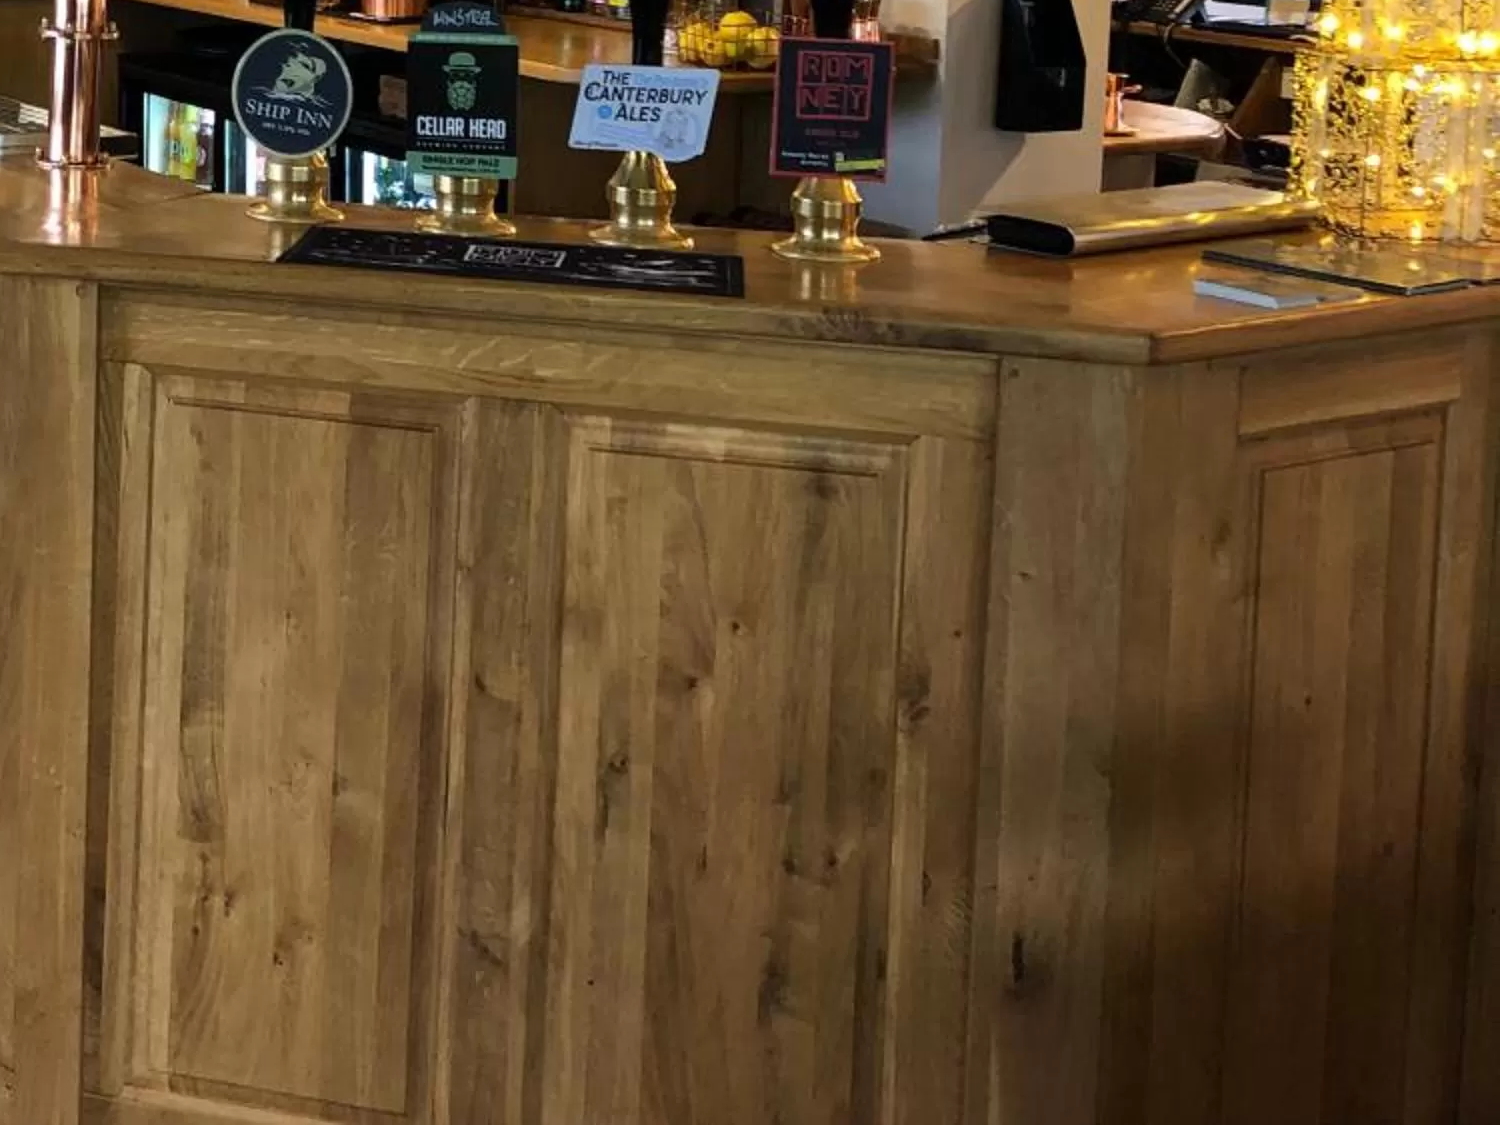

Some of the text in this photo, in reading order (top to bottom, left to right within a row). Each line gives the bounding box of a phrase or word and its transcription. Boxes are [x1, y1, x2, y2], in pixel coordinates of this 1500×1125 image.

[603, 70, 631, 85] THE
[584, 82, 708, 106] CANTERBURY
[245, 98, 291, 120] SHIP
[297, 108, 333, 129] INN
[614, 103, 661, 122] ALES
[416, 116, 507, 140] CELLAR HEAD
